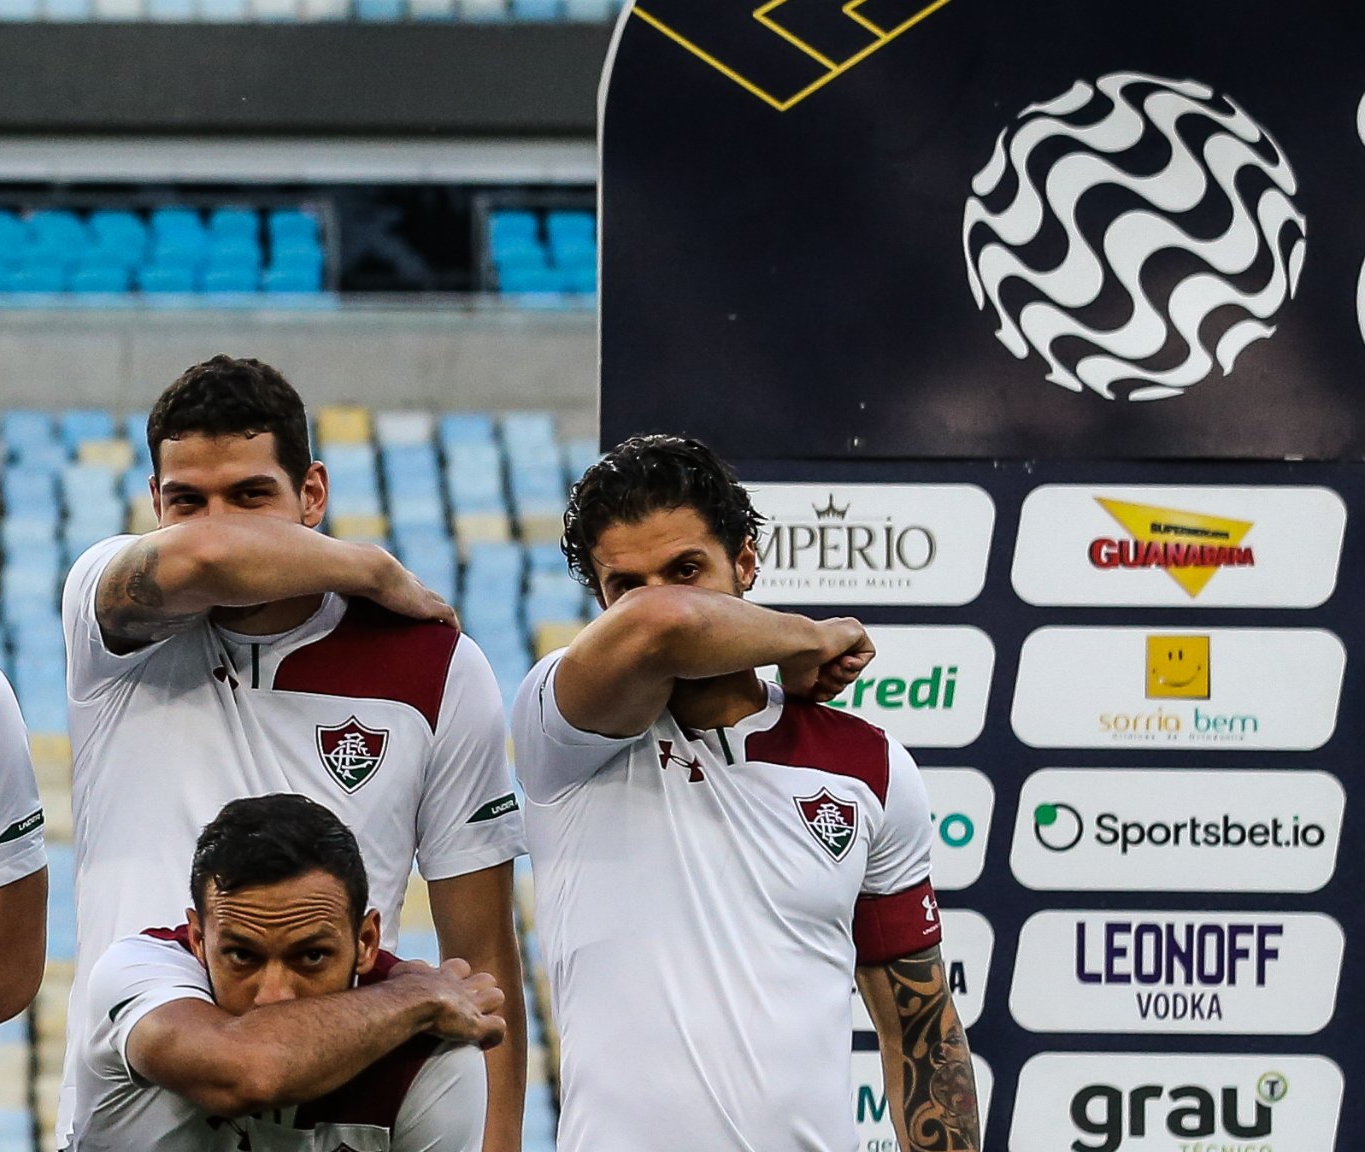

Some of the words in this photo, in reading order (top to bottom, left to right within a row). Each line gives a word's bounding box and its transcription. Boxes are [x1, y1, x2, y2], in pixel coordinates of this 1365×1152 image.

[756, 515, 936, 570] MPERIO
[1089, 537, 1255, 570] GUANABARA
[761, 577, 811, 589] ERVEJA
[1099, 707, 1183, 732] sorria
[1193, 707, 1259, 732] bem
[1094, 812, 1326, 855] Sportsbet.io
[1076, 922, 1284, 987] LEONOFF
[1135, 992, 1223, 1021] VODKA
